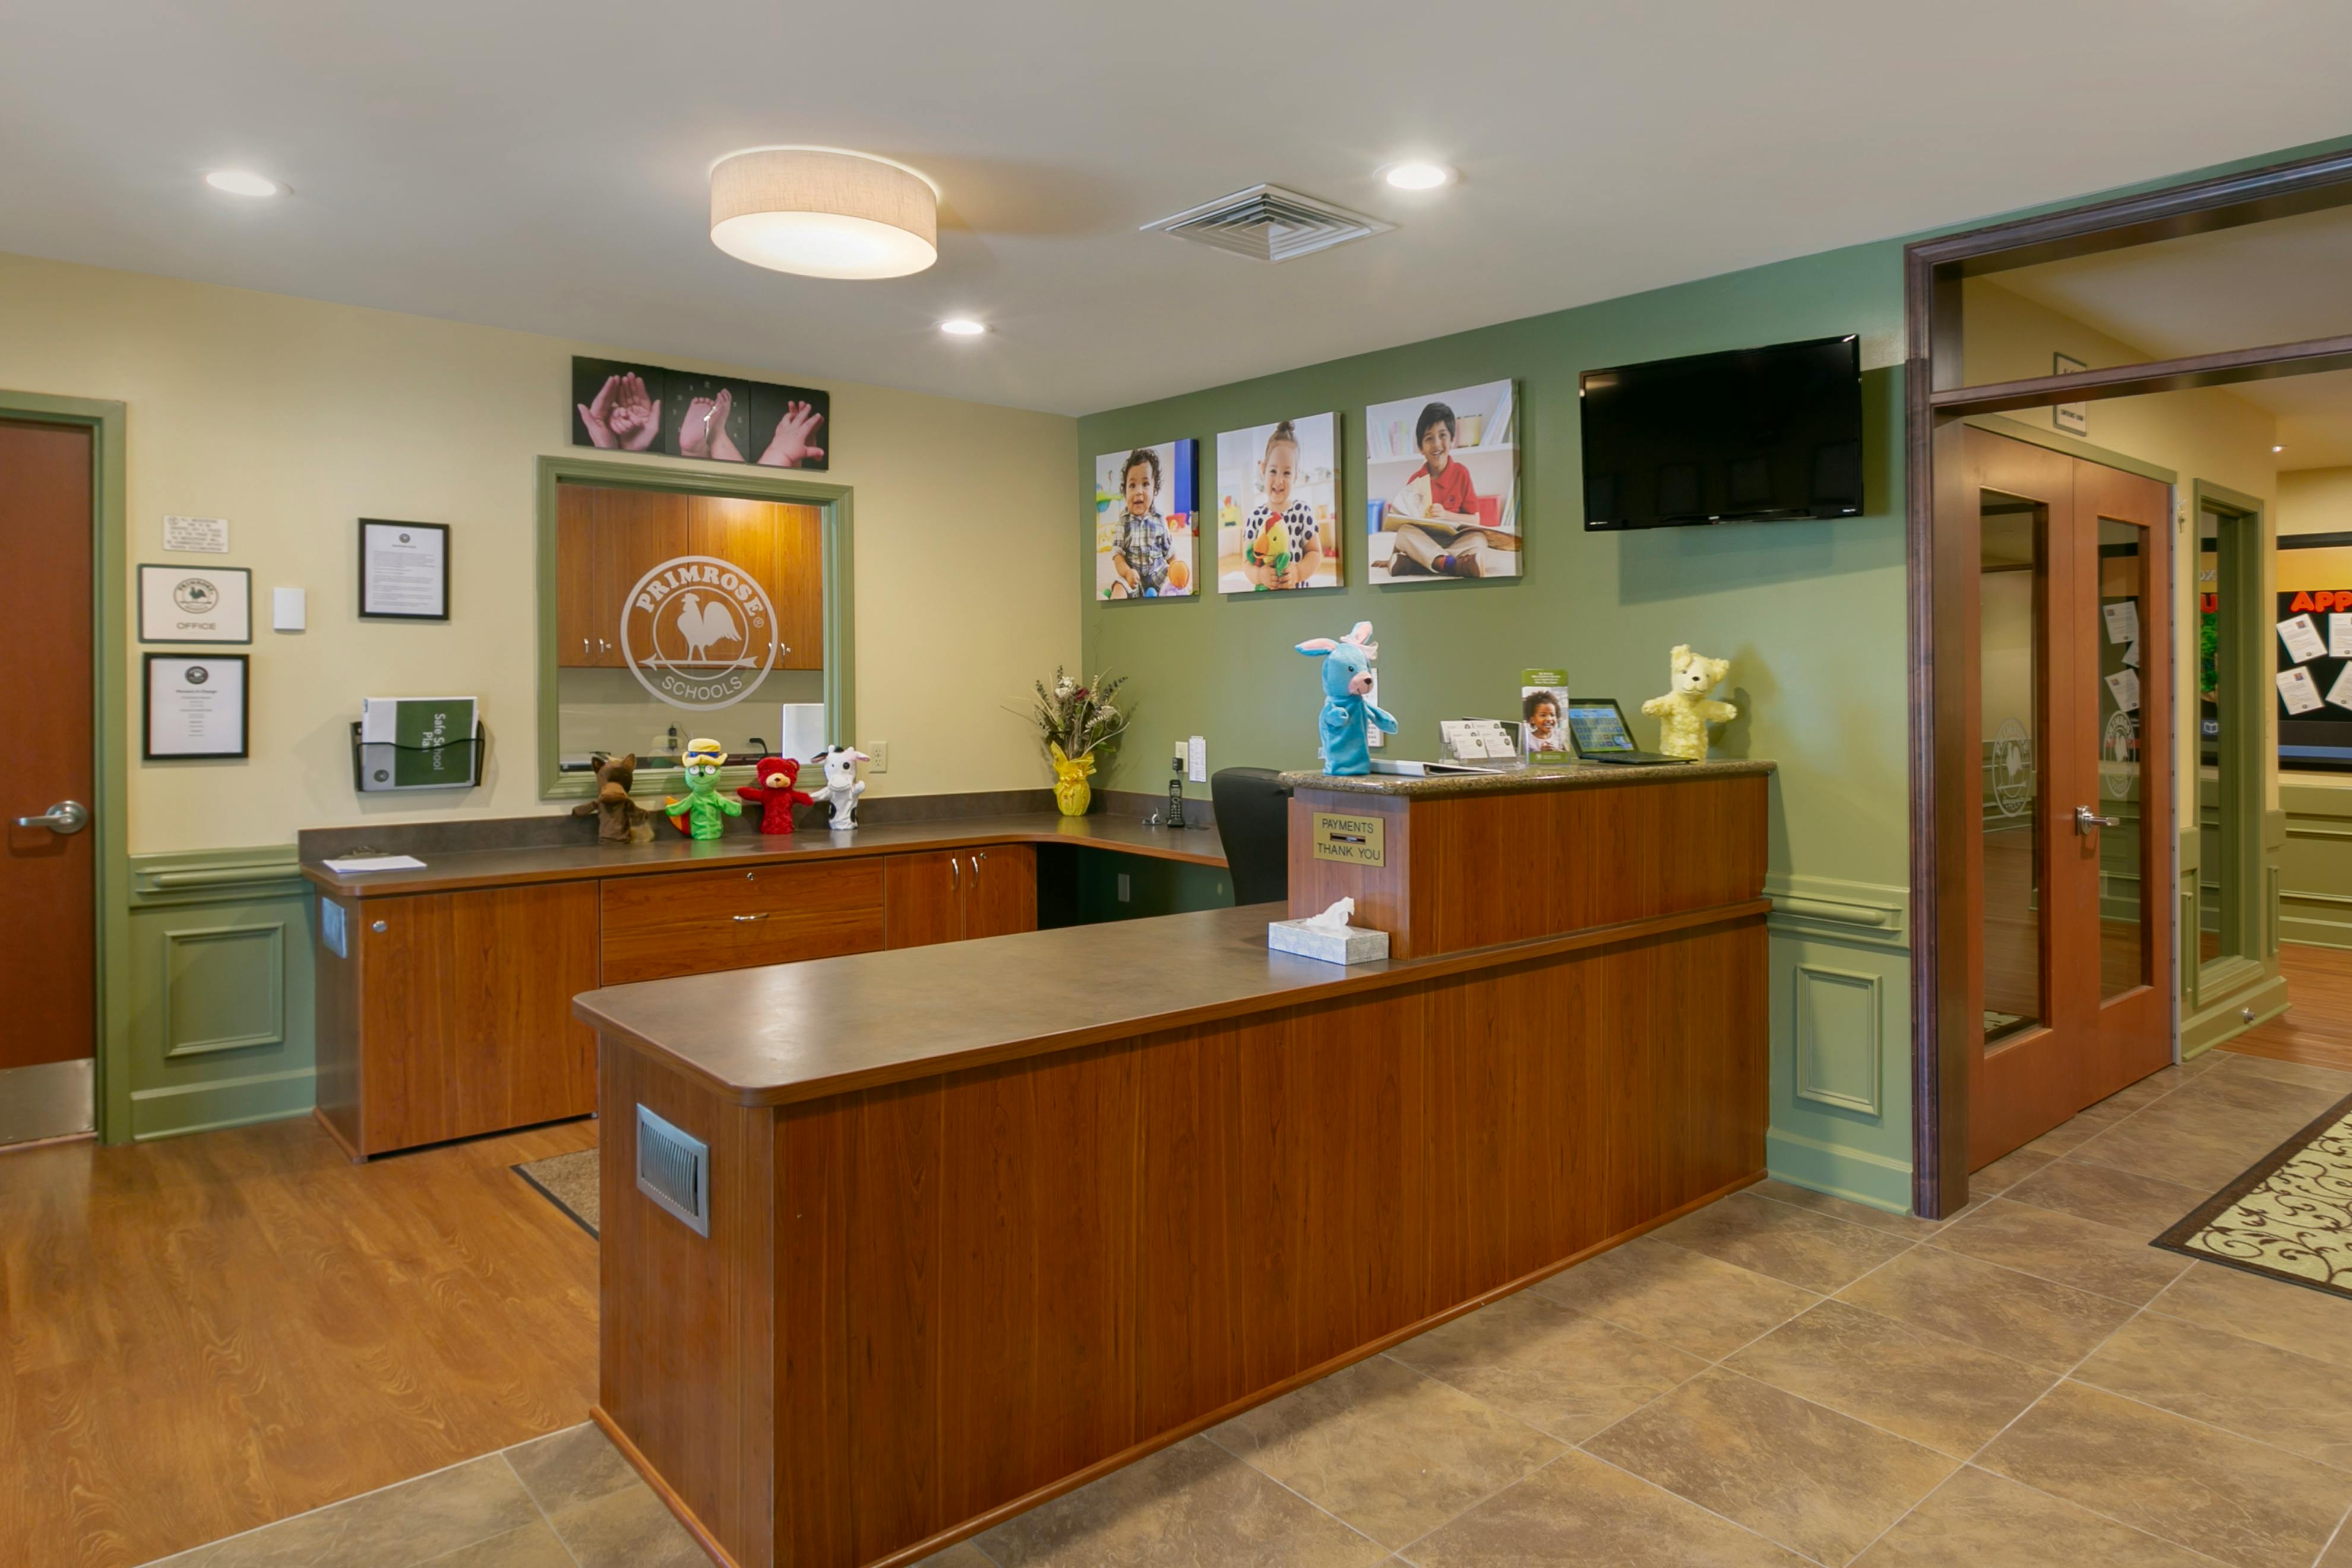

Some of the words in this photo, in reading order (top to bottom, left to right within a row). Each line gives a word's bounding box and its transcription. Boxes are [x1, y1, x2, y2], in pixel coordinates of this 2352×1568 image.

[636, 565, 763, 617] PRIMROSE
[662, 676, 742, 700] SCHOOLS
[434, 713, 446, 735] Safe
[1322, 818, 1374, 834] PAYMENTS
[1317, 842, 1354, 857] THANK
[1358, 848, 1381, 860] YOU
